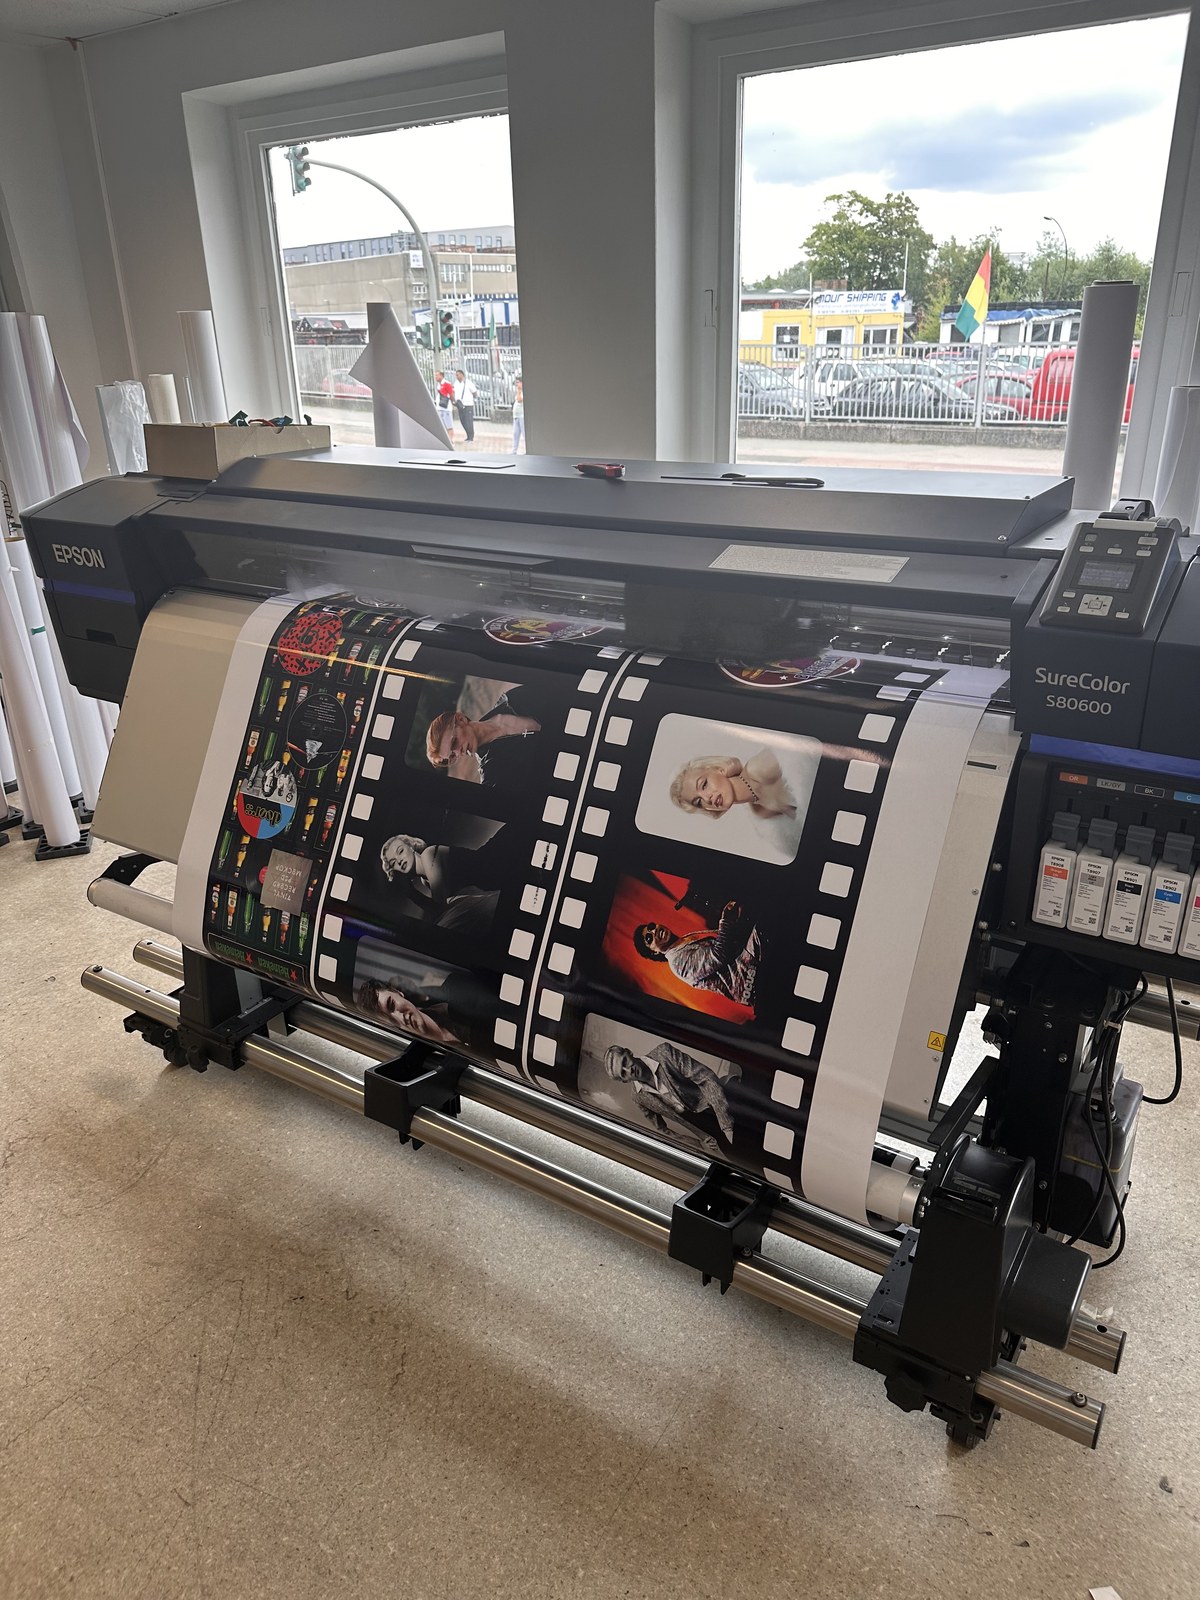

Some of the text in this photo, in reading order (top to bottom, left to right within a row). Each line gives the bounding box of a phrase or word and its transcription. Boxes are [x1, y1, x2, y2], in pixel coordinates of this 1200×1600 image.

[847, 292, 887, 302] SHIPPING
[52, 543, 105, 569] EPSON
[1035, 667, 1130, 694] SureColor
[1046, 695, 1112, 715] S80600
[741, 968, 756, 1005] FOCUS
